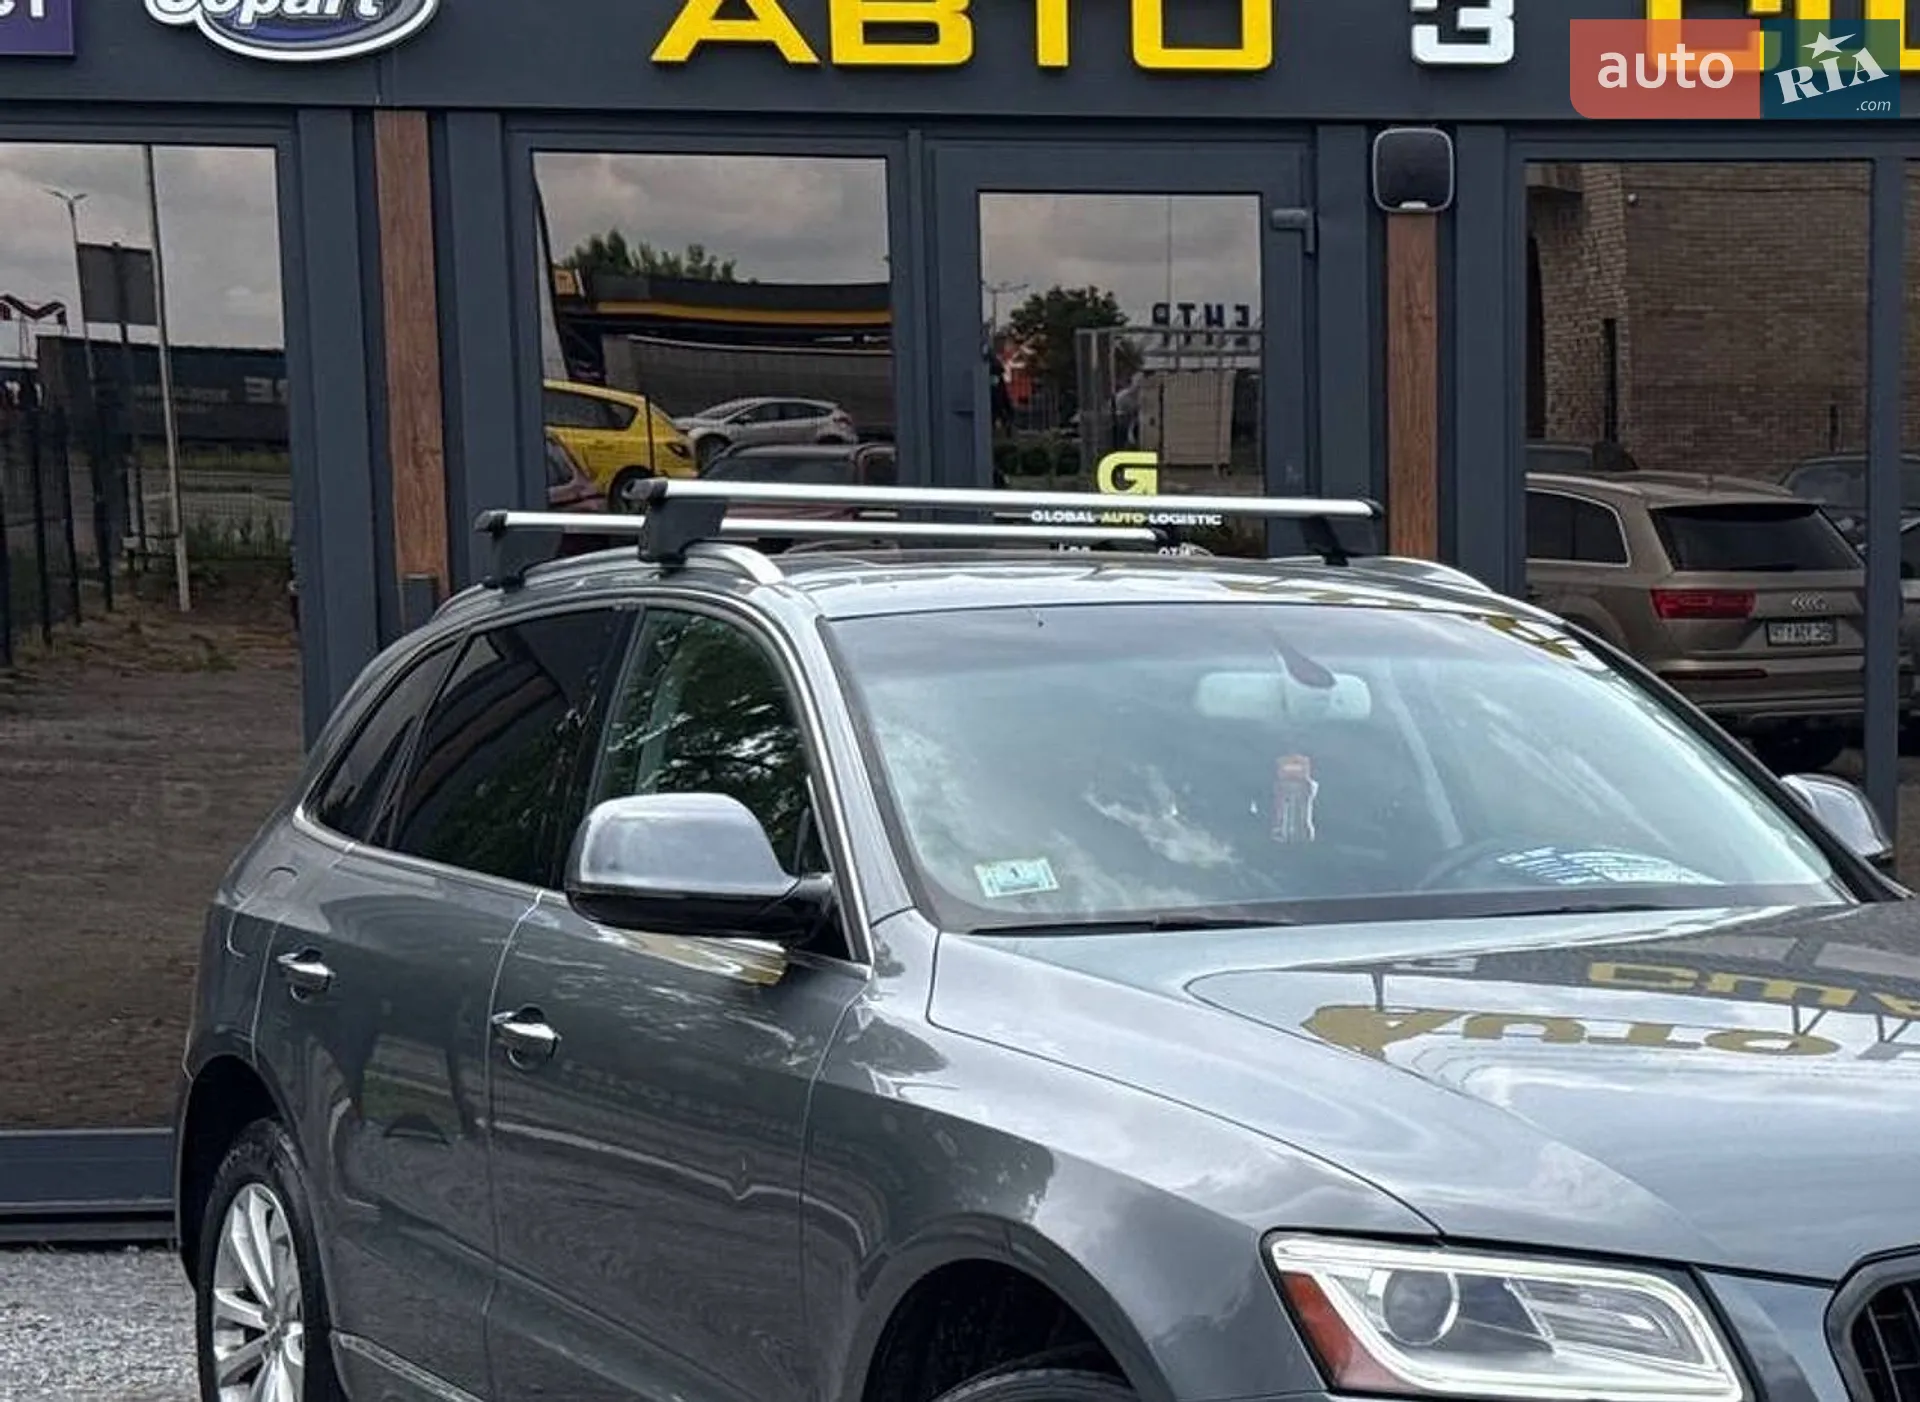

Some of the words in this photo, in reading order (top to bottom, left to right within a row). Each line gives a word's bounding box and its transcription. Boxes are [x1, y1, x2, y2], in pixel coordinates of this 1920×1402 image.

[1096, 451, 1158, 496] G
[1031, 511, 1095, 523] GLOBAL
[1100, 512, 1146, 524] AUTO
[1148, 513, 1223, 526] LOGISTIC
